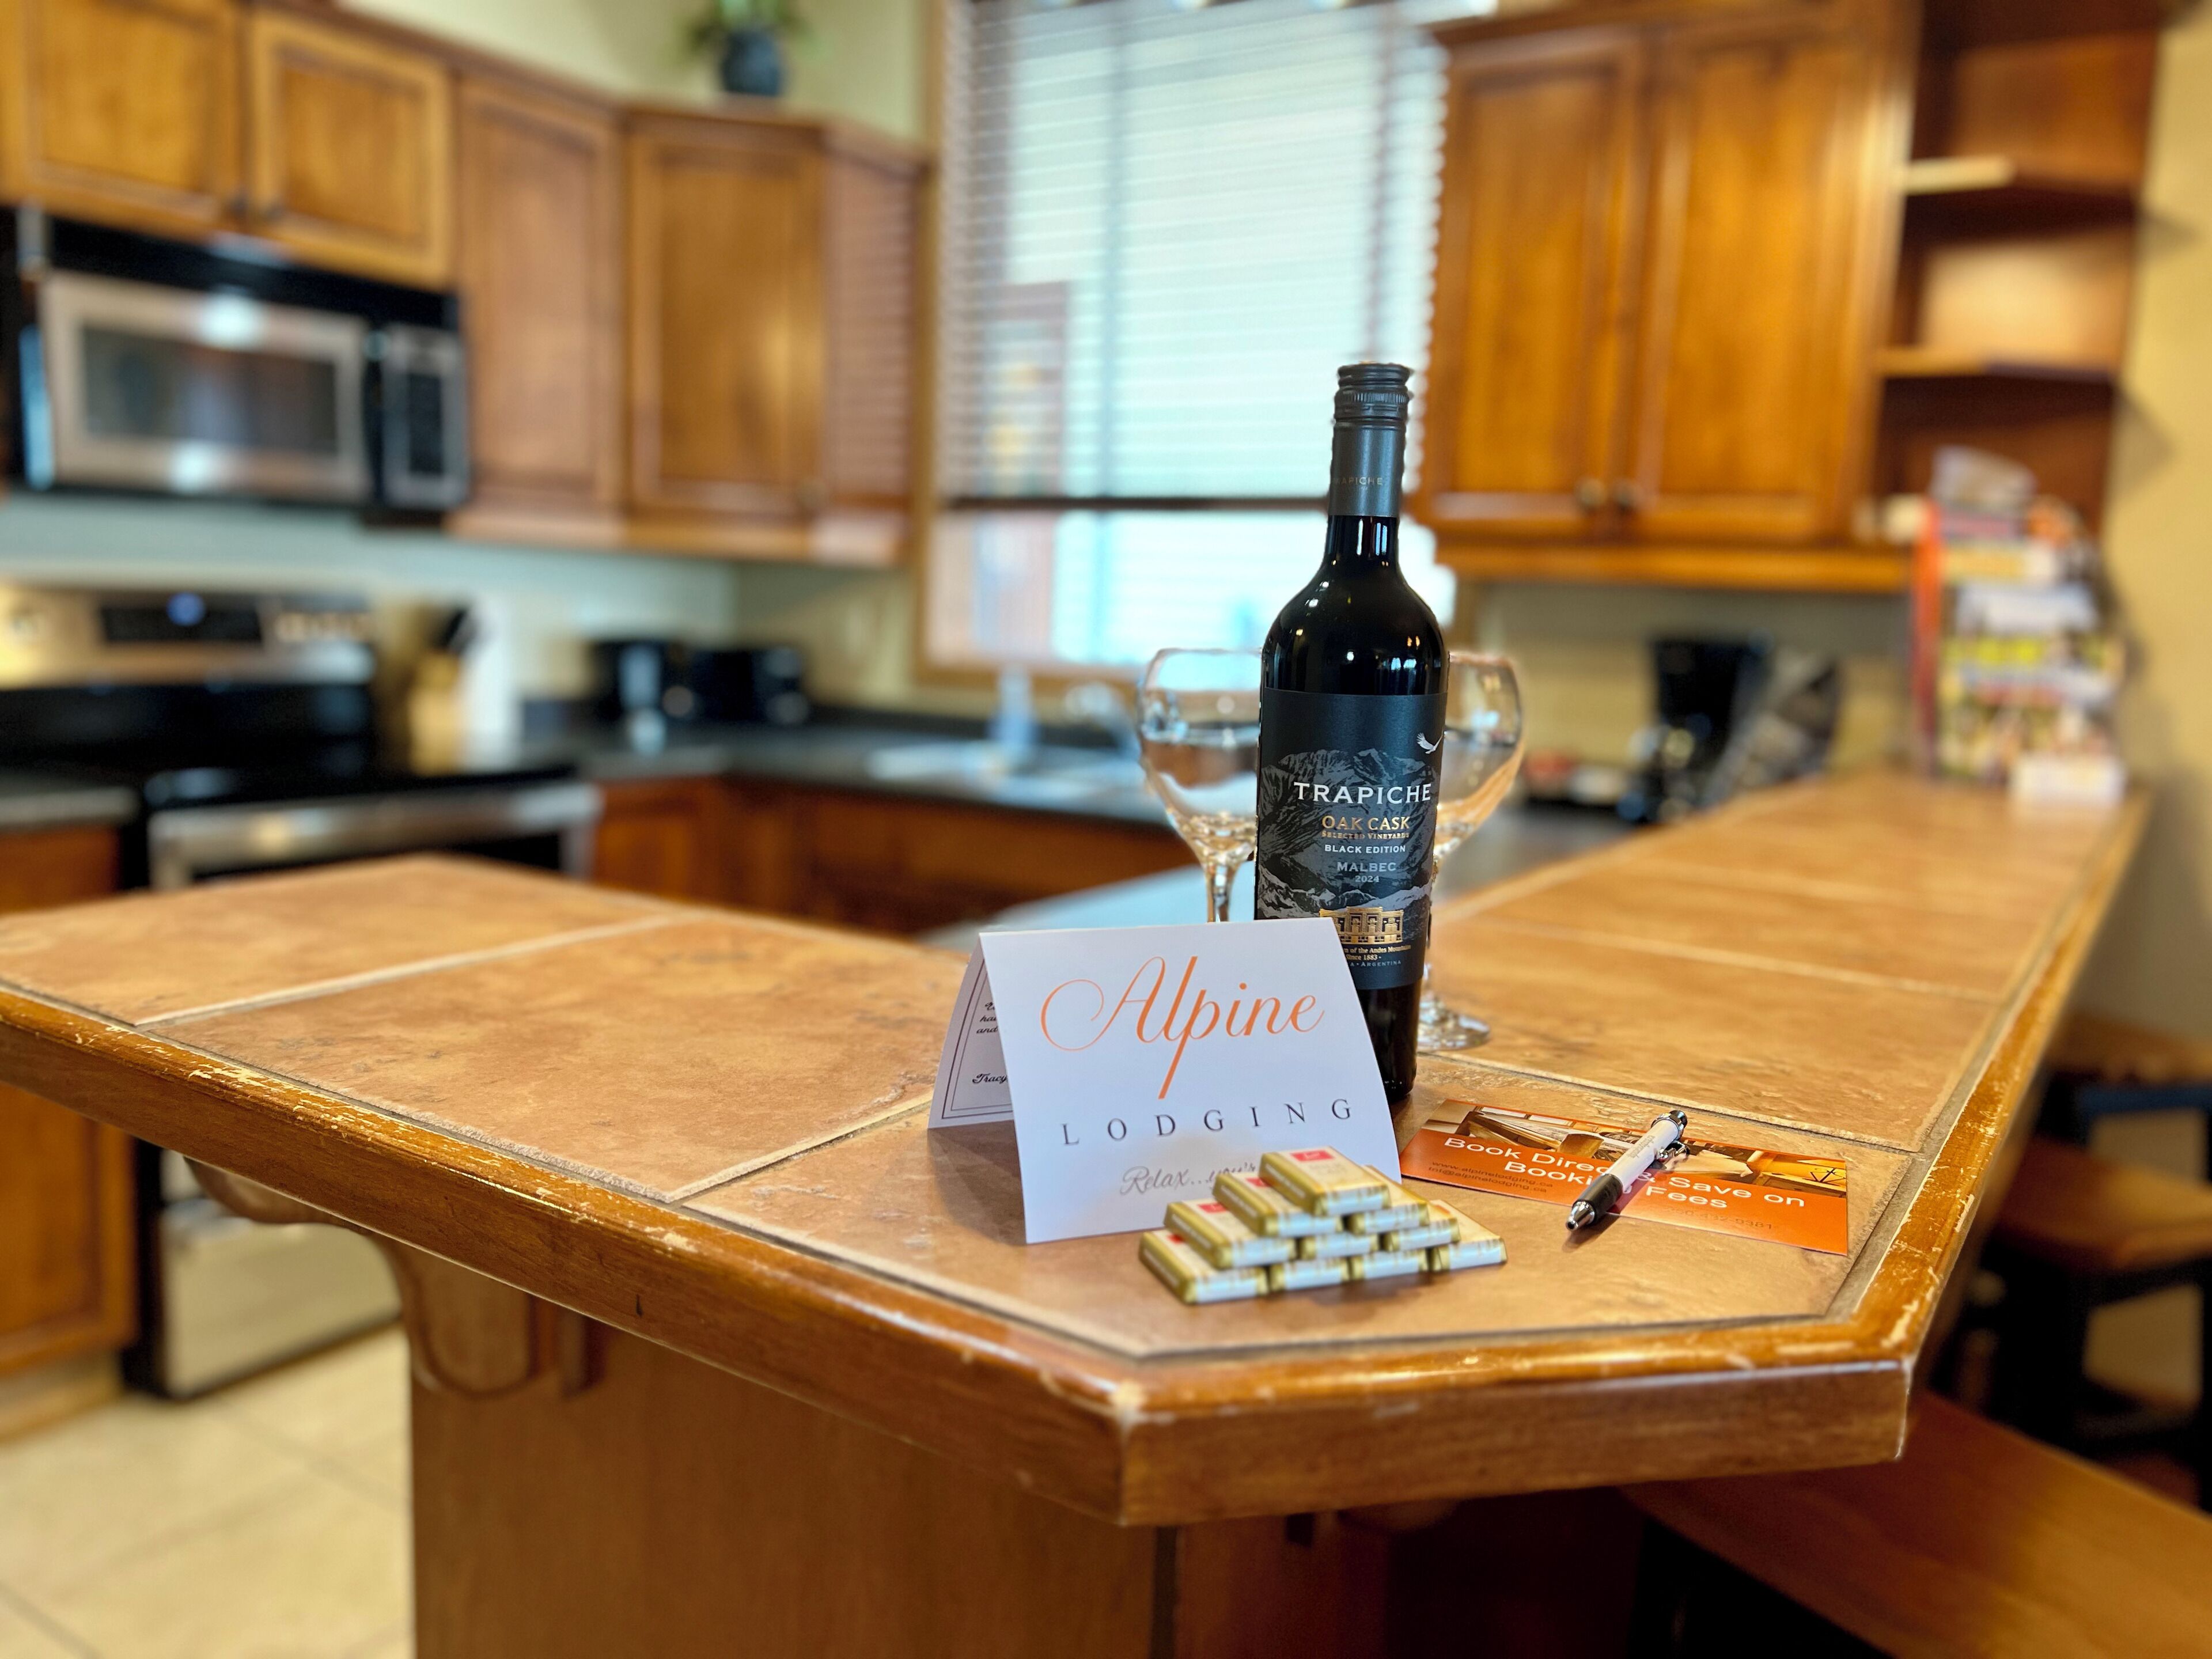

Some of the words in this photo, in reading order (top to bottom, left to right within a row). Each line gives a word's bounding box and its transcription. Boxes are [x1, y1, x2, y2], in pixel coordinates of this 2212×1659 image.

[1293, 781, 1432, 805] TRAPICHE
[1321, 815, 1363, 830] OAK
[1368, 816, 1410, 831] CASK
[1324, 844, 1362, 854] BLACK
[1365, 844, 1406, 854] EDITION
[1336, 861, 1397, 873] MALBEC
[1355, 874, 1380, 883] 2024
[1039, 956, 1325, 1100] Alpine
[1063, 1097, 1353, 1147] LODGING
[1444, 1137, 1521, 1159] Book
[1668, 1176, 1752, 1199] Save
[1763, 1194, 1805, 1207] on
[1645, 1185, 1728, 1209] Fees
